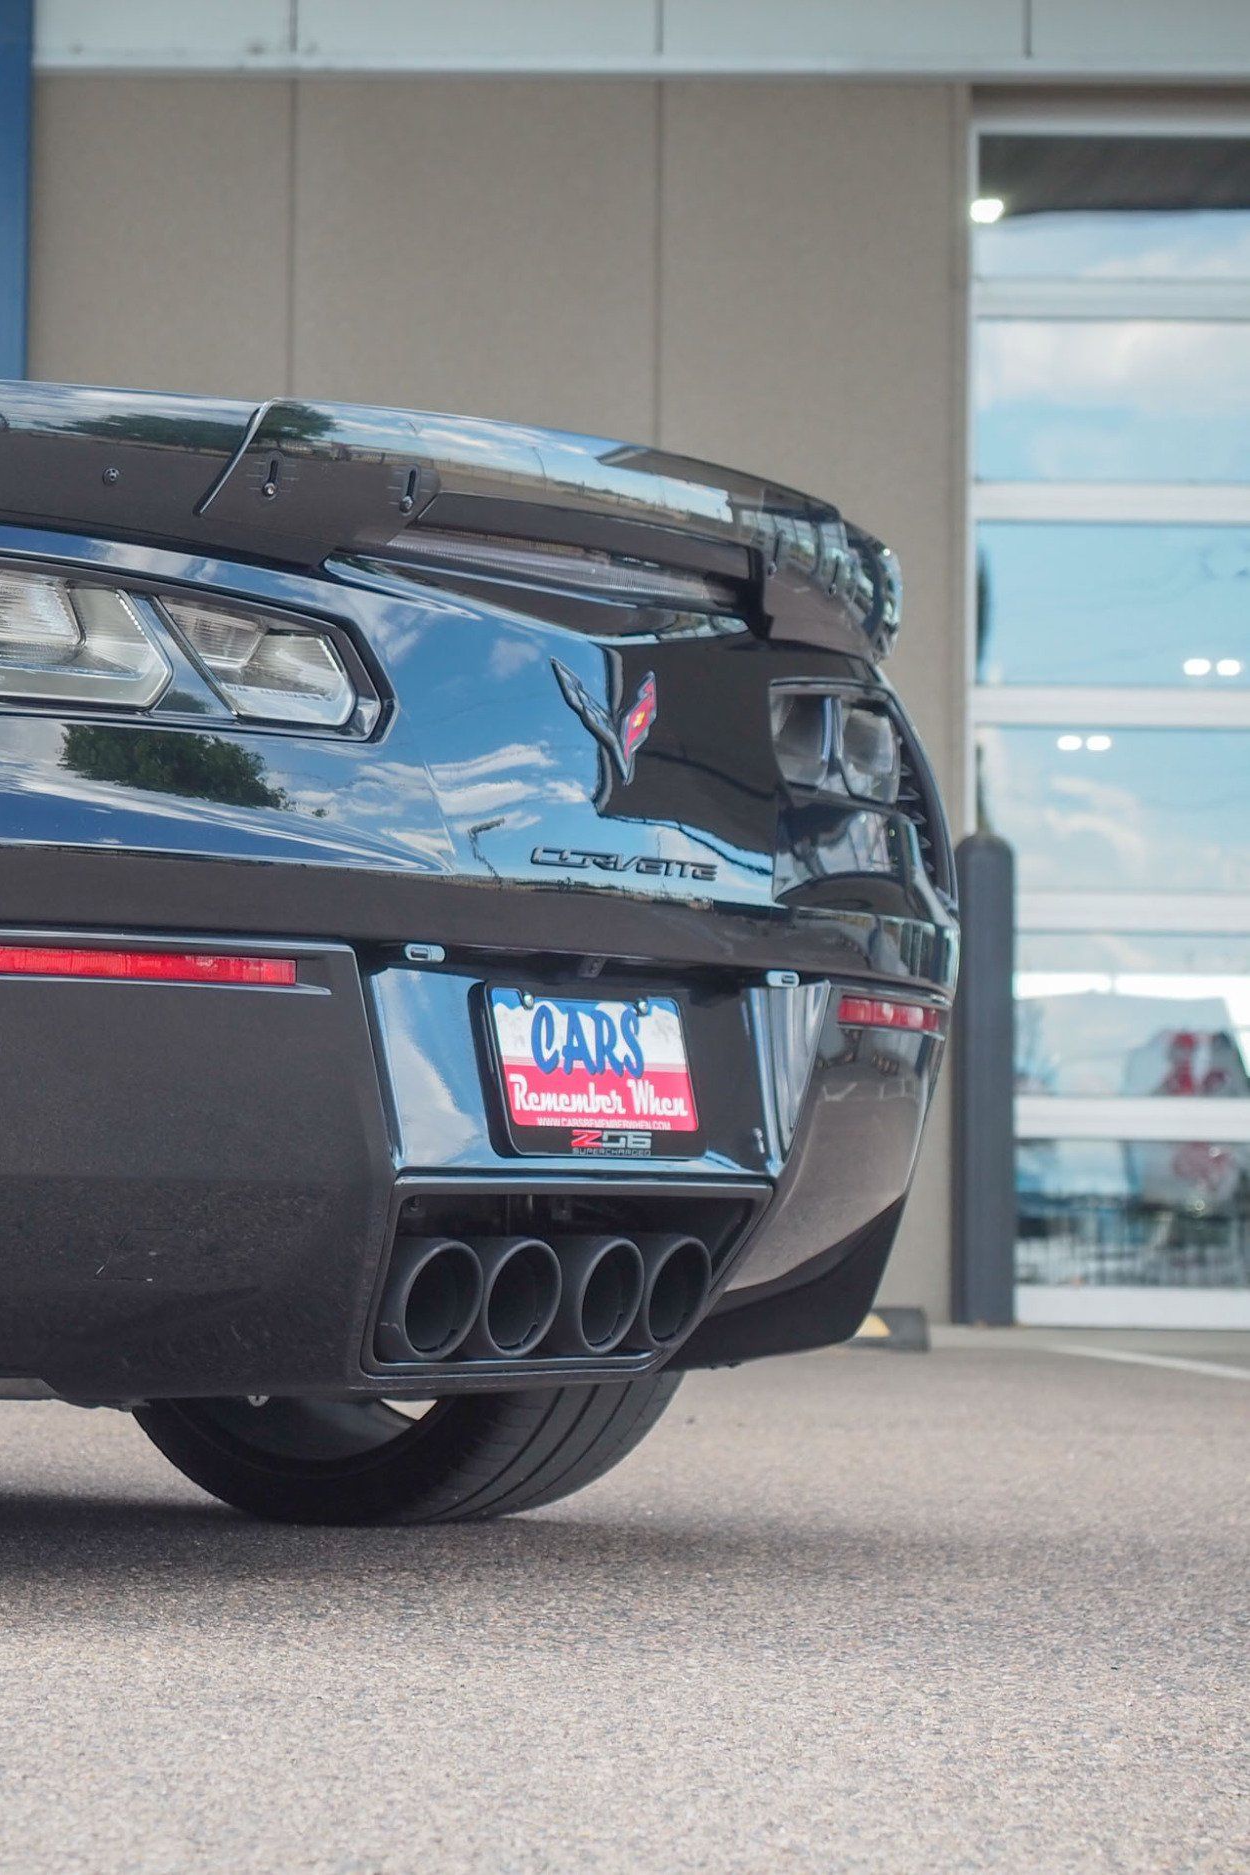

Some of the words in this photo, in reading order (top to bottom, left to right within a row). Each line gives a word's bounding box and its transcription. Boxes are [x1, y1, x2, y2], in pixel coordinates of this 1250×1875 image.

[530, 847, 718, 882] CORVETTE
[531, 1004, 645, 1079] CARS
[509, 1074, 626, 1115] Remember
[627, 1078, 689, 1117] When
[570, 1129, 652, 1149] Z06
[572, 1147, 652, 1157] SUPERCHARGED
